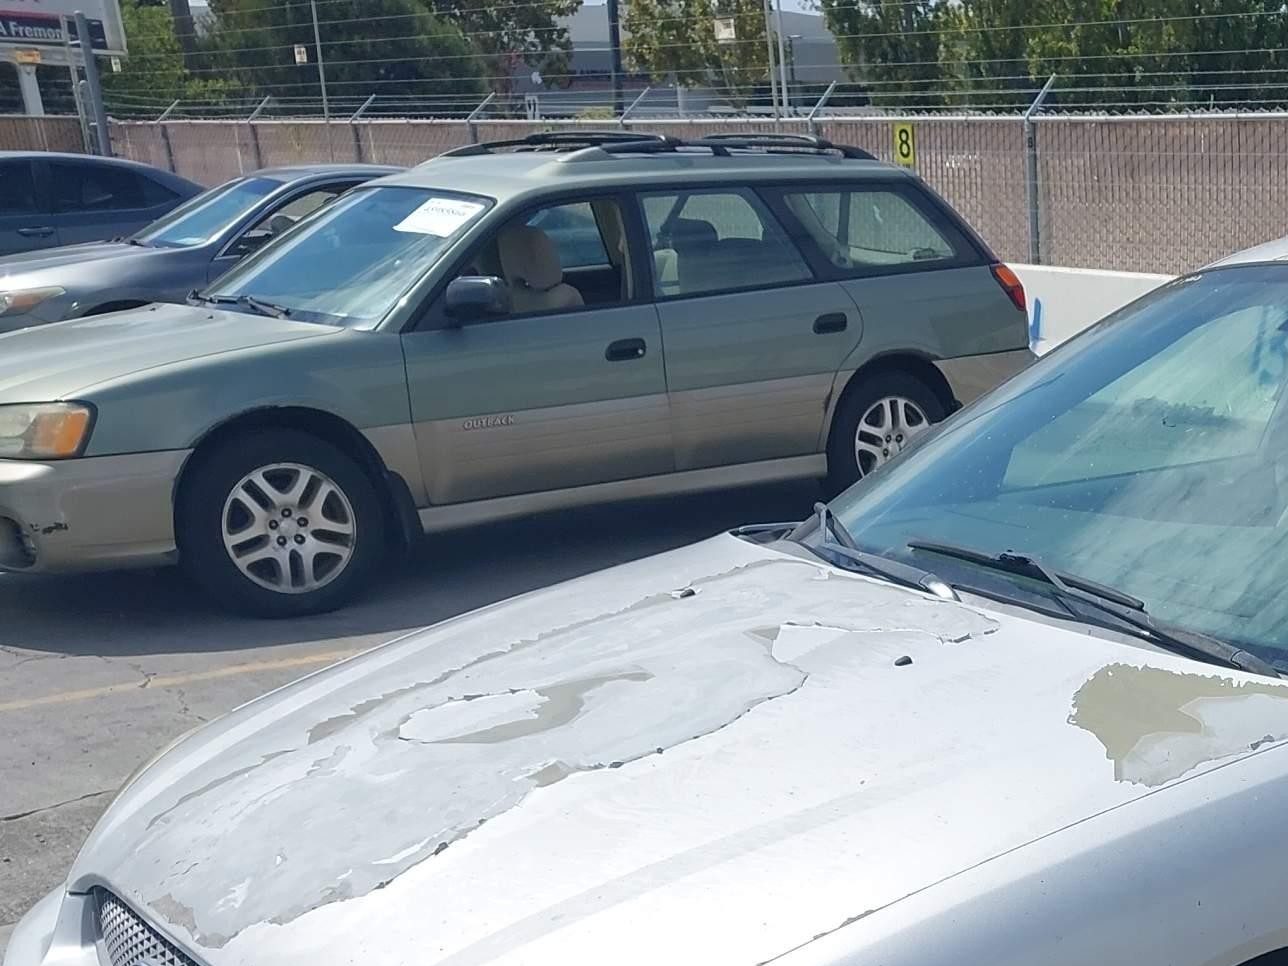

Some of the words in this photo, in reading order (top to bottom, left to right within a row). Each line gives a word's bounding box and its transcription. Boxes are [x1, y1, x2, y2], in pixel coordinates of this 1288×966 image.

[9, 20, 65, 39] Fremon
[898, 128, 911, 159] 8
[463, 415, 516, 431] OUTBACK
